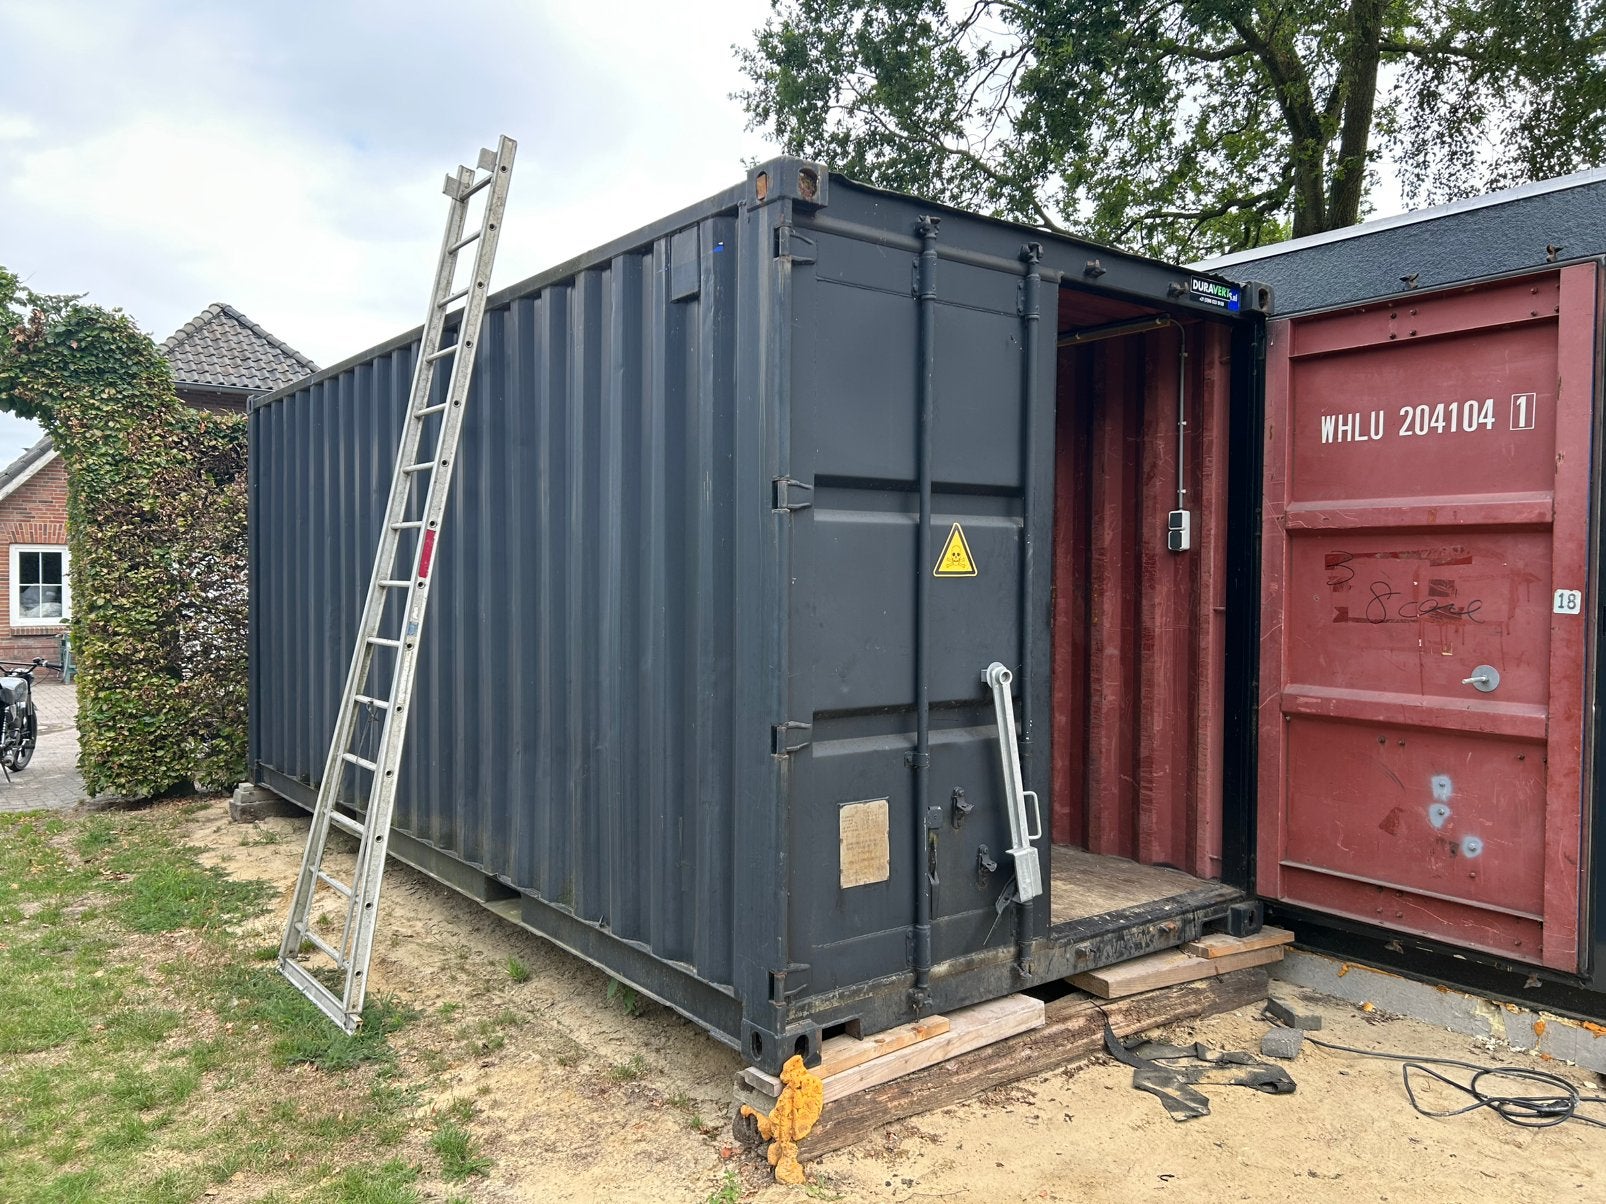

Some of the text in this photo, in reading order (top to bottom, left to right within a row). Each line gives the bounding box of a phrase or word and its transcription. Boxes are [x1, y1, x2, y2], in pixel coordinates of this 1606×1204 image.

[1321, 410, 1385, 444] WHLU
[1398, 398, 1496, 437] 204104
[1556, 592, 1577, 610] 18
